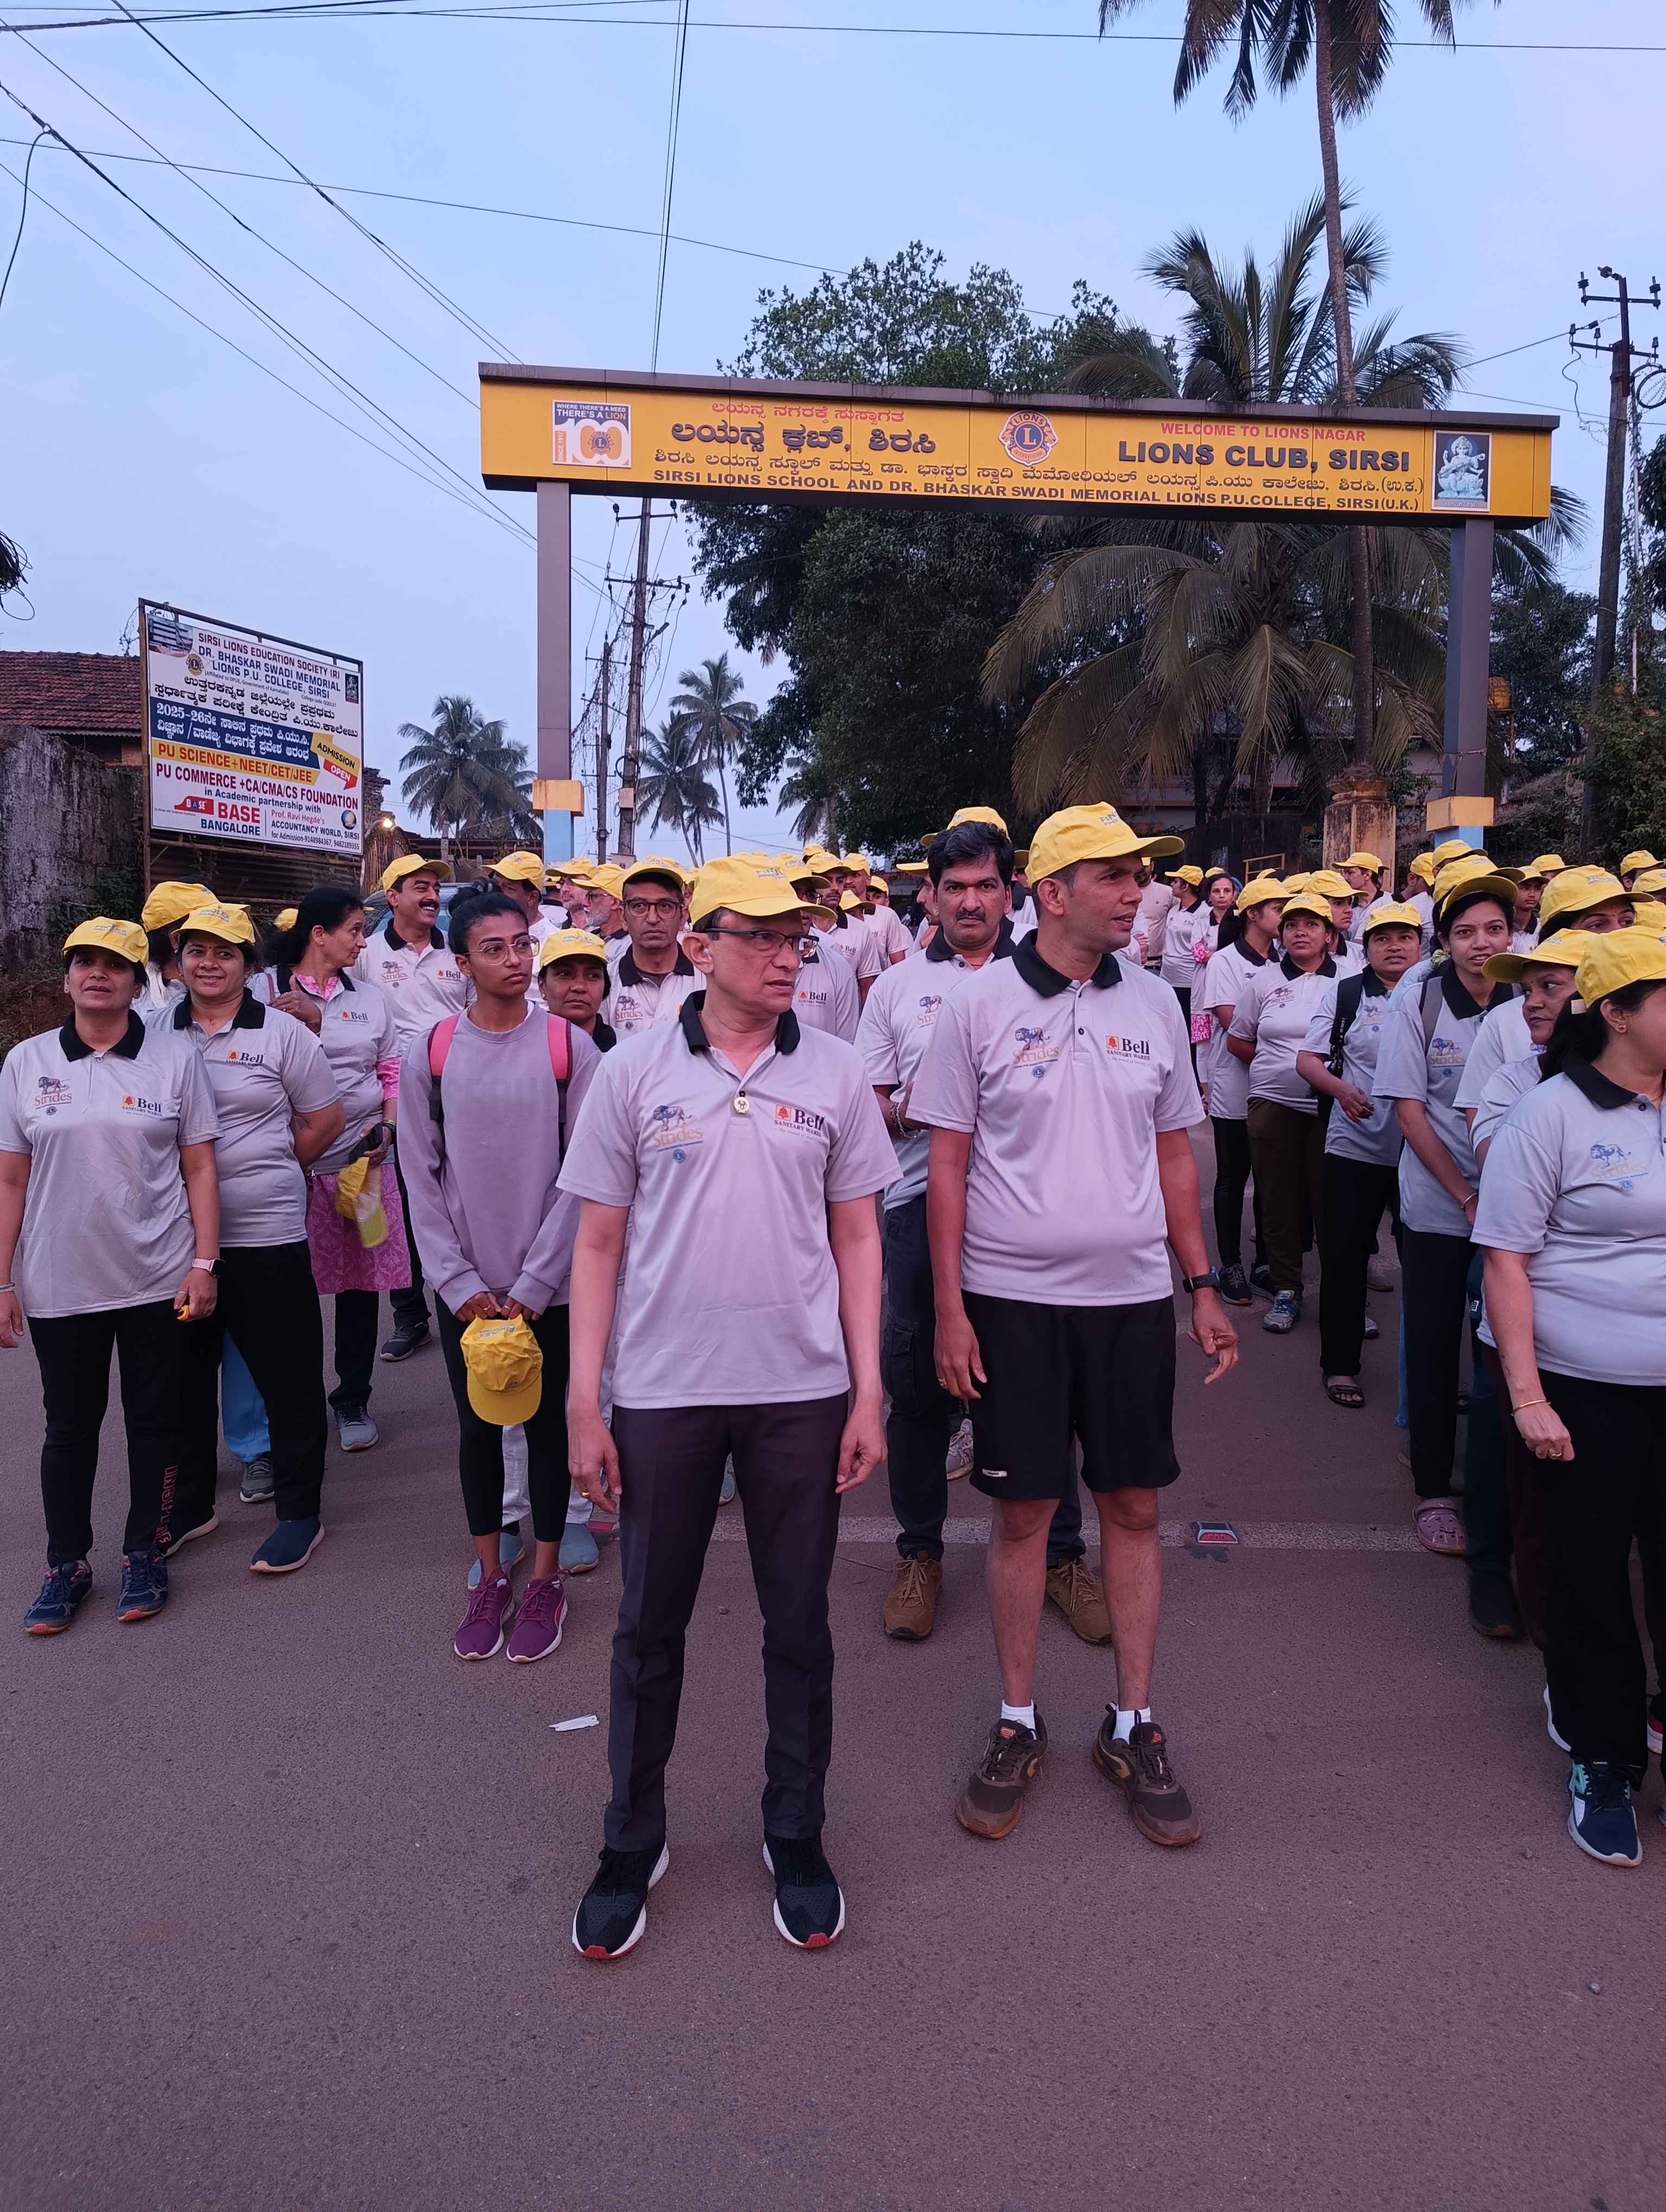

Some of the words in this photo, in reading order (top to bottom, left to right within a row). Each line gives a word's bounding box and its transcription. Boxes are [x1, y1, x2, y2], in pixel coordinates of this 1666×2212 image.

[556, 409, 594, 417] THERE'S
[774, 405, 829, 423] ನಗರಕ್ಕೆ
[835, 407, 904, 425] ಸುಸ್ವಾಗತ
[1014, 414, 1045, 425] LIONS
[868, 428, 936, 453] ಶಿರಸಿ
[1023, 428, 1036, 445] L
[1161, 423, 1235, 436] WELCOME
[1240, 426, 1260, 437] TO
[1265, 427, 1309, 439] LIONS
[1315, 428, 1366, 441] NAGAR
[1119, 441, 1214, 465] LIONS
[1226, 446, 1318, 473] CLUB,
[1329, 449, 1409, 471] SIRSI
[655, 449, 695, 464] ಶಿರಸಿ
[770, 456, 821, 475] ಸ್ಕೂಲ್
[829, 458, 873, 475] ಮತ್ತು
[881, 462, 907, 474] ಡಾ.
[917, 464, 967, 481] ಭಾಸ್ಕರ
[977, 467, 1013, 484] ಸ್ವಾದಿ
[1206, 475, 1252, 487] ಪಿ.ಯು
[654, 470, 700, 483] SIRSI
[707, 473, 761, 485] LIONS
[767, 475, 839, 488] SCHOOL
[847, 479, 883, 491] AND
[889, 481, 917, 492] DR.
[924, 482, 1007, 496] BHASKAR
[1011, 486, 1064, 499] SWADI
[1071, 488, 1160, 501] MEMORIAL
[1167, 492, 1216, 504] LIONS
[198, 633, 221, 647] SIRSI
[223, 640, 248, 654] LIONS
[251, 647, 294, 667] EDUCATION
[297, 660, 328, 676] SOCIETY
[330, 670, 340, 679] (R)
[199, 646, 214, 658] DR.
[219, 651, 261, 670] BHASKAR
[265, 663, 293, 678] SWADI
[296, 671, 341, 691] MEMORIAL
[213, 660, 240, 676] LIONS
[244, 668, 261, 681] P.U.
[265, 674, 305, 693] COLLEGE,
[309, 686, 329, 699] SIRSI
[184, 677, 245, 700] ಉತ್ತರಕನ್ನಡ
[300, 704, 335, 719] ಪ್ರಪ್ರಥಮ
[251, 705, 287, 722] ಕೇಂದ್ರಿತ
[221, 718, 246, 732] ಸಾಲಿನ
[250, 722, 273, 738] ಪ್ರಥಮ
[157, 719, 184, 739] ವಿಜ್ಞಾನ
[259, 740, 282, 755] ಪ್ರವೇಶ
[286, 744, 309, 761] ಆರಂಭ
[158, 743, 175, 757] PU
[317, 742, 355, 769] ADMISSION
[331, 765, 351, 782] OPEN
[156, 763, 171, 778] PU
[175, 766, 236, 789] COMMERCE
[301, 788, 358, 810] FOUNDATION
[186, 799, 206, 810] BASE
[204, 787, 213, 796] in
[215, 788, 255, 803] Academic
[259, 796, 303, 812] partnership
[305, 803, 321, 813] with
[218, 802, 260, 824] BASE
[271, 809, 286, 818] Prof.
[287, 812, 300, 820] Ravi
[302, 815, 325, 825] Hegde's
[201, 819, 260, 835] BANGALORE
[272, 820, 318, 834] ACCOUNTANCY
[321, 828, 343, 839] WORLD,
[344, 831, 360, 840] SIRSI
[445, 970, 460, 979] Bell
[810, 992, 826, 1001] Bell
[350, 1011, 368, 1020] Bell
[1121, 1037, 1149, 1054] Bell
[240, 1052, 264, 1064] Bell
[1013, 1047, 1059, 1064] Strides
[1106, 1049, 1131, 1058] SANITARY
[1133, 1053, 1150, 1061] WARES
[35, 1093, 72, 1106] Strides
[138, 1097, 162, 1113] Bell
[774, 1120, 804, 1131] SANITARY
[794, 1108, 824, 1131] Bell
